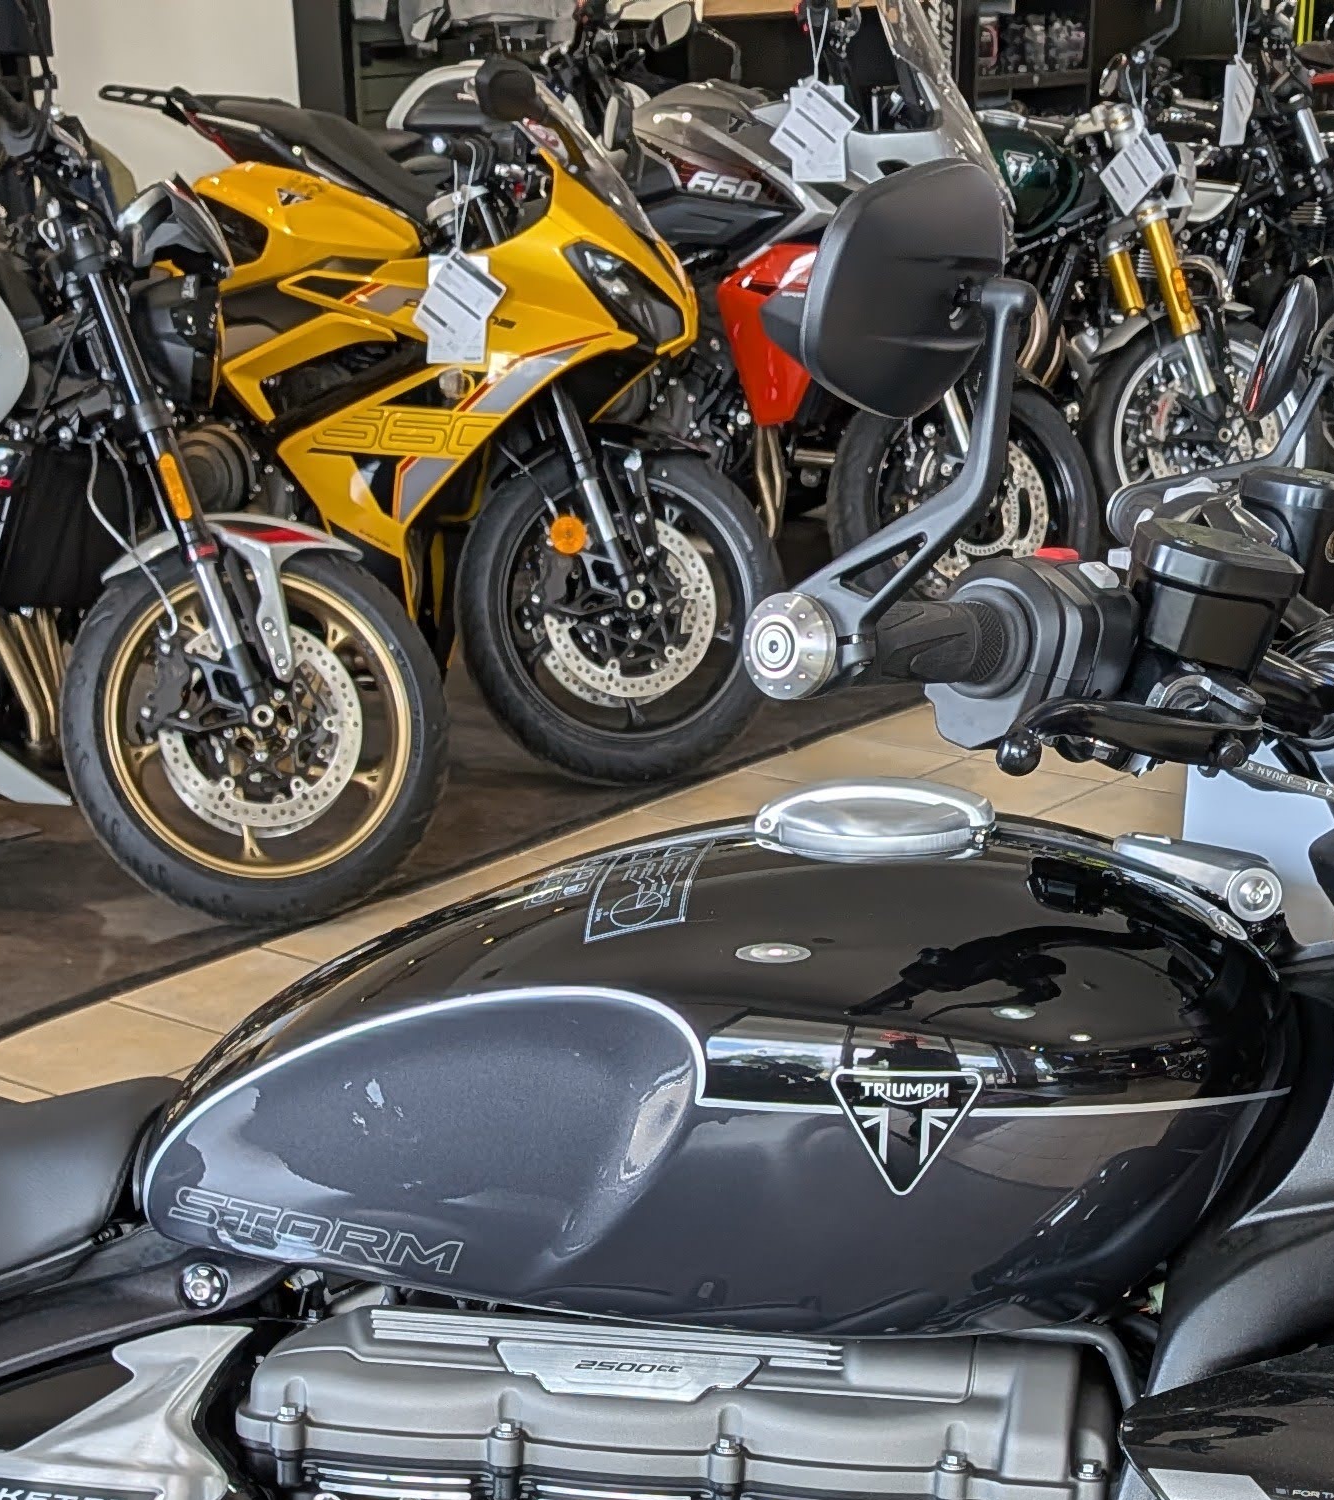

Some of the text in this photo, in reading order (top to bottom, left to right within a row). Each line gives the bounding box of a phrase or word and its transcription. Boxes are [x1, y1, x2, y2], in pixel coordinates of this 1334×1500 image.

[686, 171, 762, 201] 660
[312, 408, 501, 455] 660
[860, 1081, 950, 1103] TRIUMPH
[168, 1186, 463, 1274] STORM
[574, 1360, 683, 1373] 2500cc
[1292, 1489, 1320, 1499] FOR
